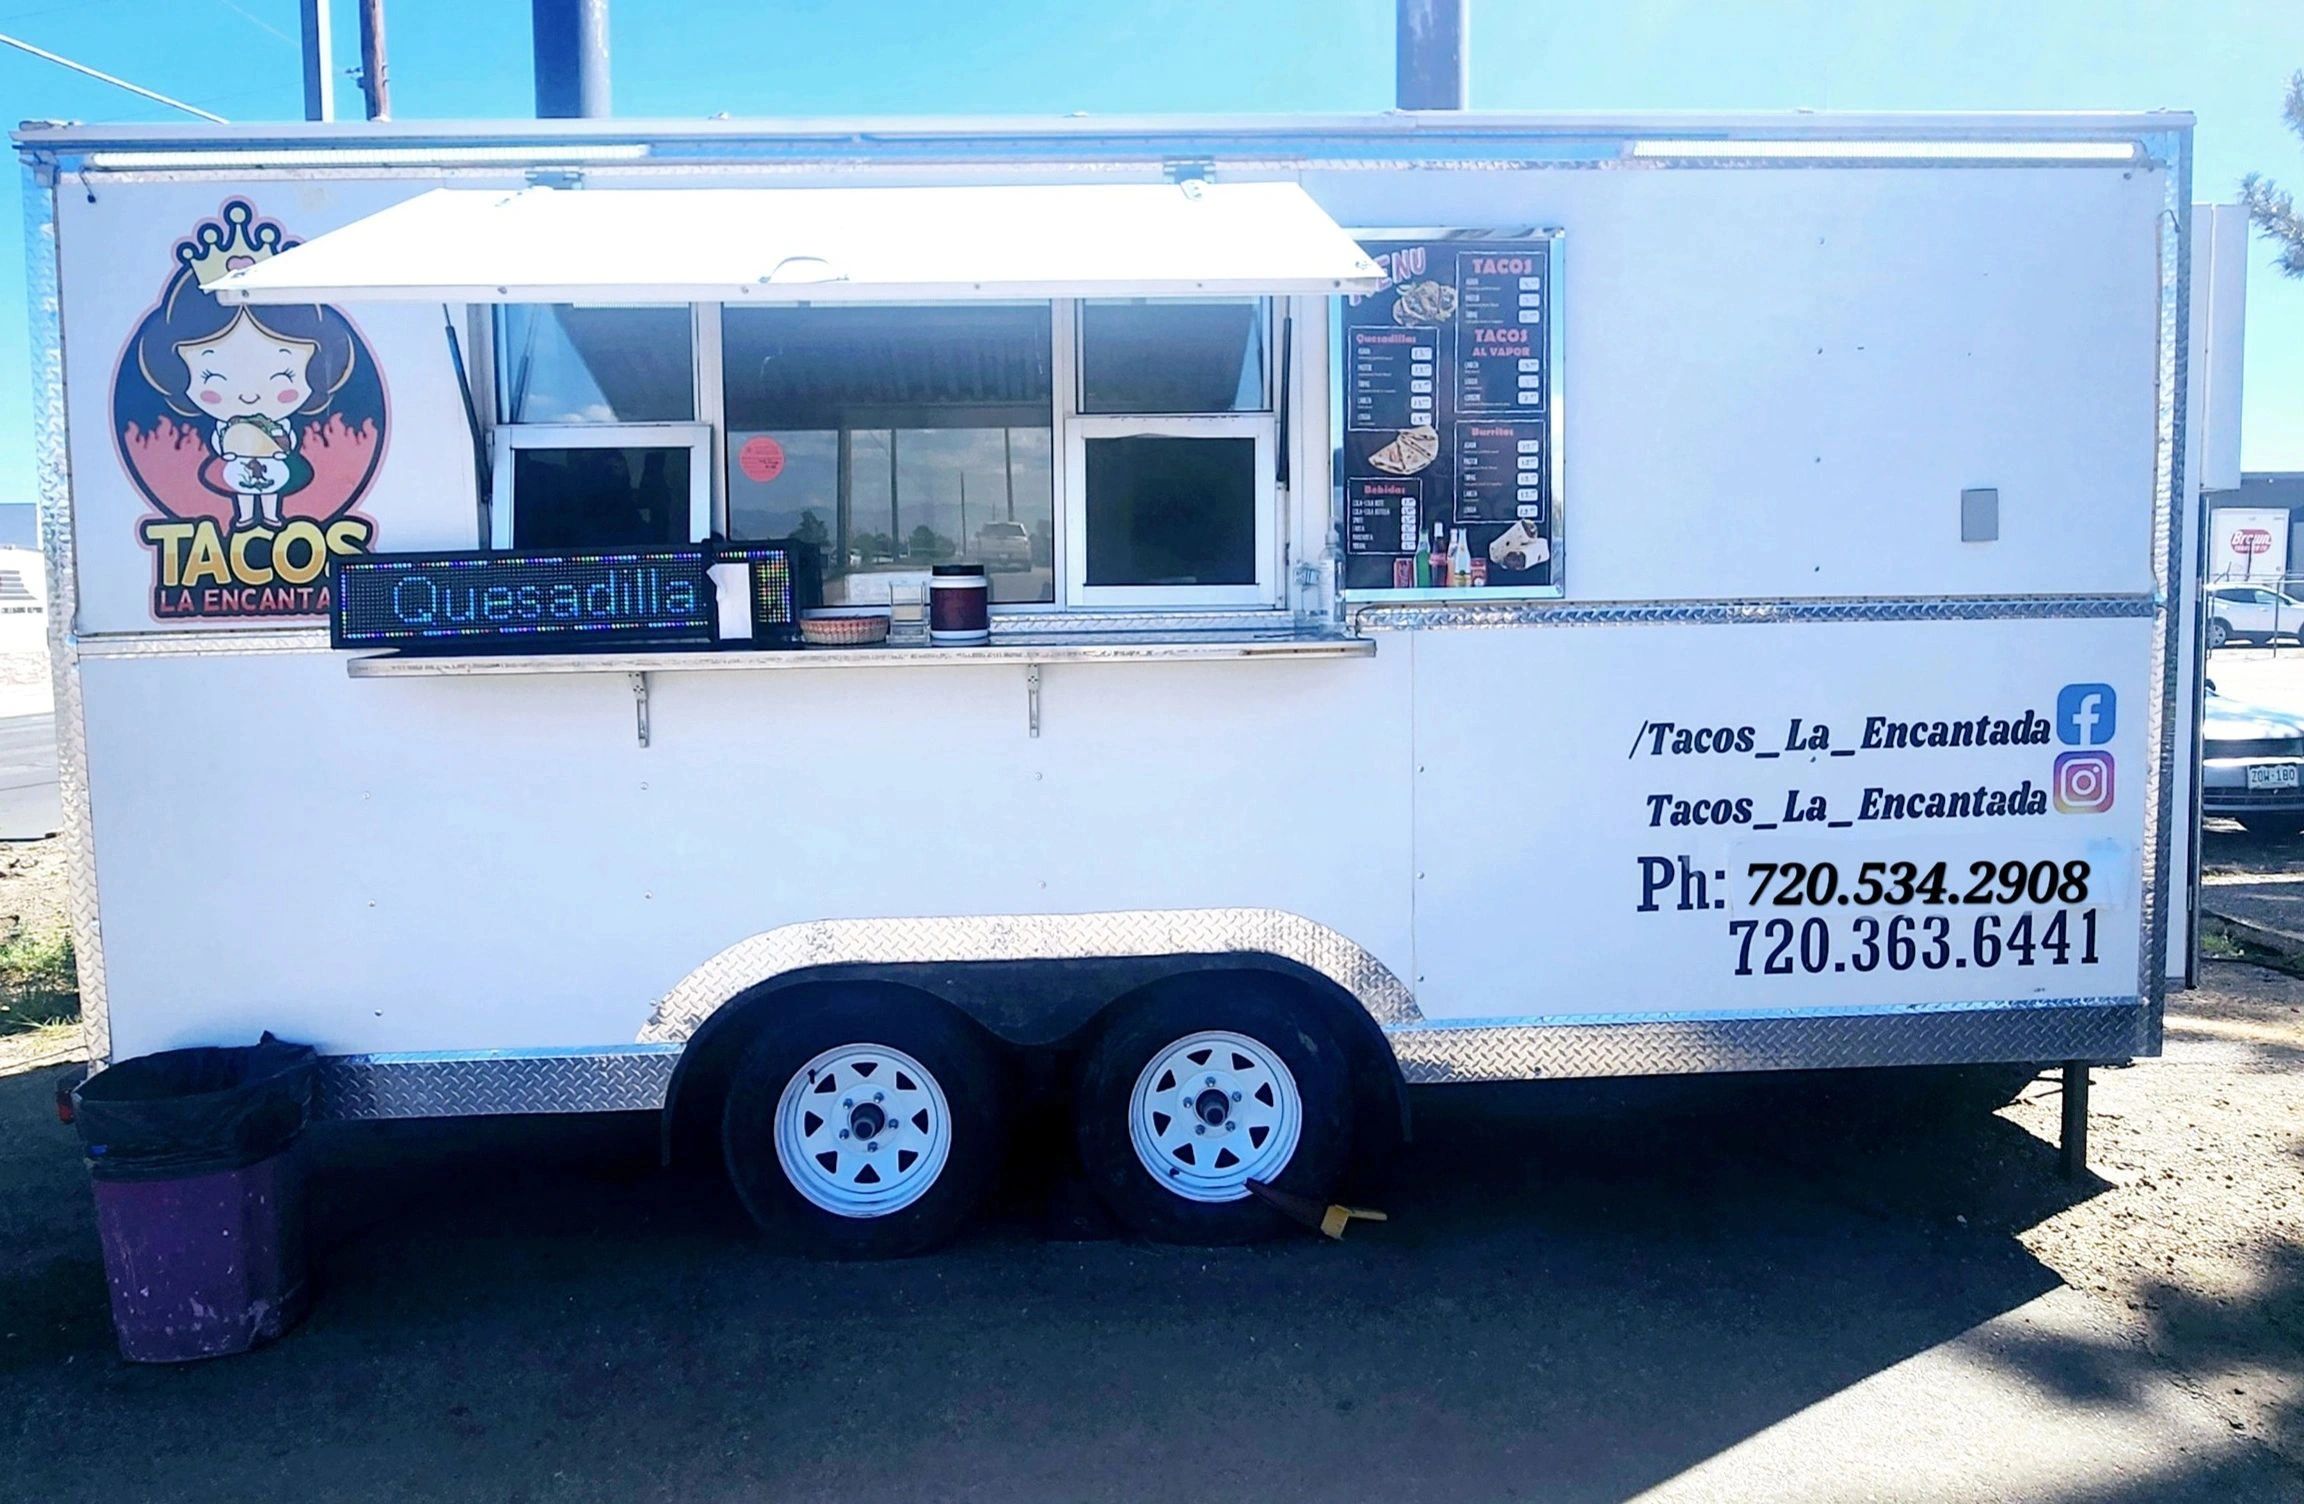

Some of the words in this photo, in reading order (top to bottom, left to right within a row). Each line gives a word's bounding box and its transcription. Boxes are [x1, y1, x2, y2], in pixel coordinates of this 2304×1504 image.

[1472, 258, 1532, 275] TACOS
[1356, 333, 1416, 344] Quesadillas
[1474, 329, 1528, 342] TACOS
[1472, 347, 1487, 357] AL
[1489, 347, 1531, 357] VAPOR
[1471, 427, 1514, 436] Burritos
[1364, 485, 1406, 494] Bebidas
[159, 590, 195, 613] LA
[393, 568, 694, 625] Quesadilla
[1628, 709, 2051, 760] /Tacos_La_Encantada
[1646, 780, 2047, 831] Tacos_La_Encantada
[1636, 854, 1726, 913] Ph:
[1747, 859, 2091, 907] 720.534.2908
[1728, 907, 2100, 976] 720.363.6441
